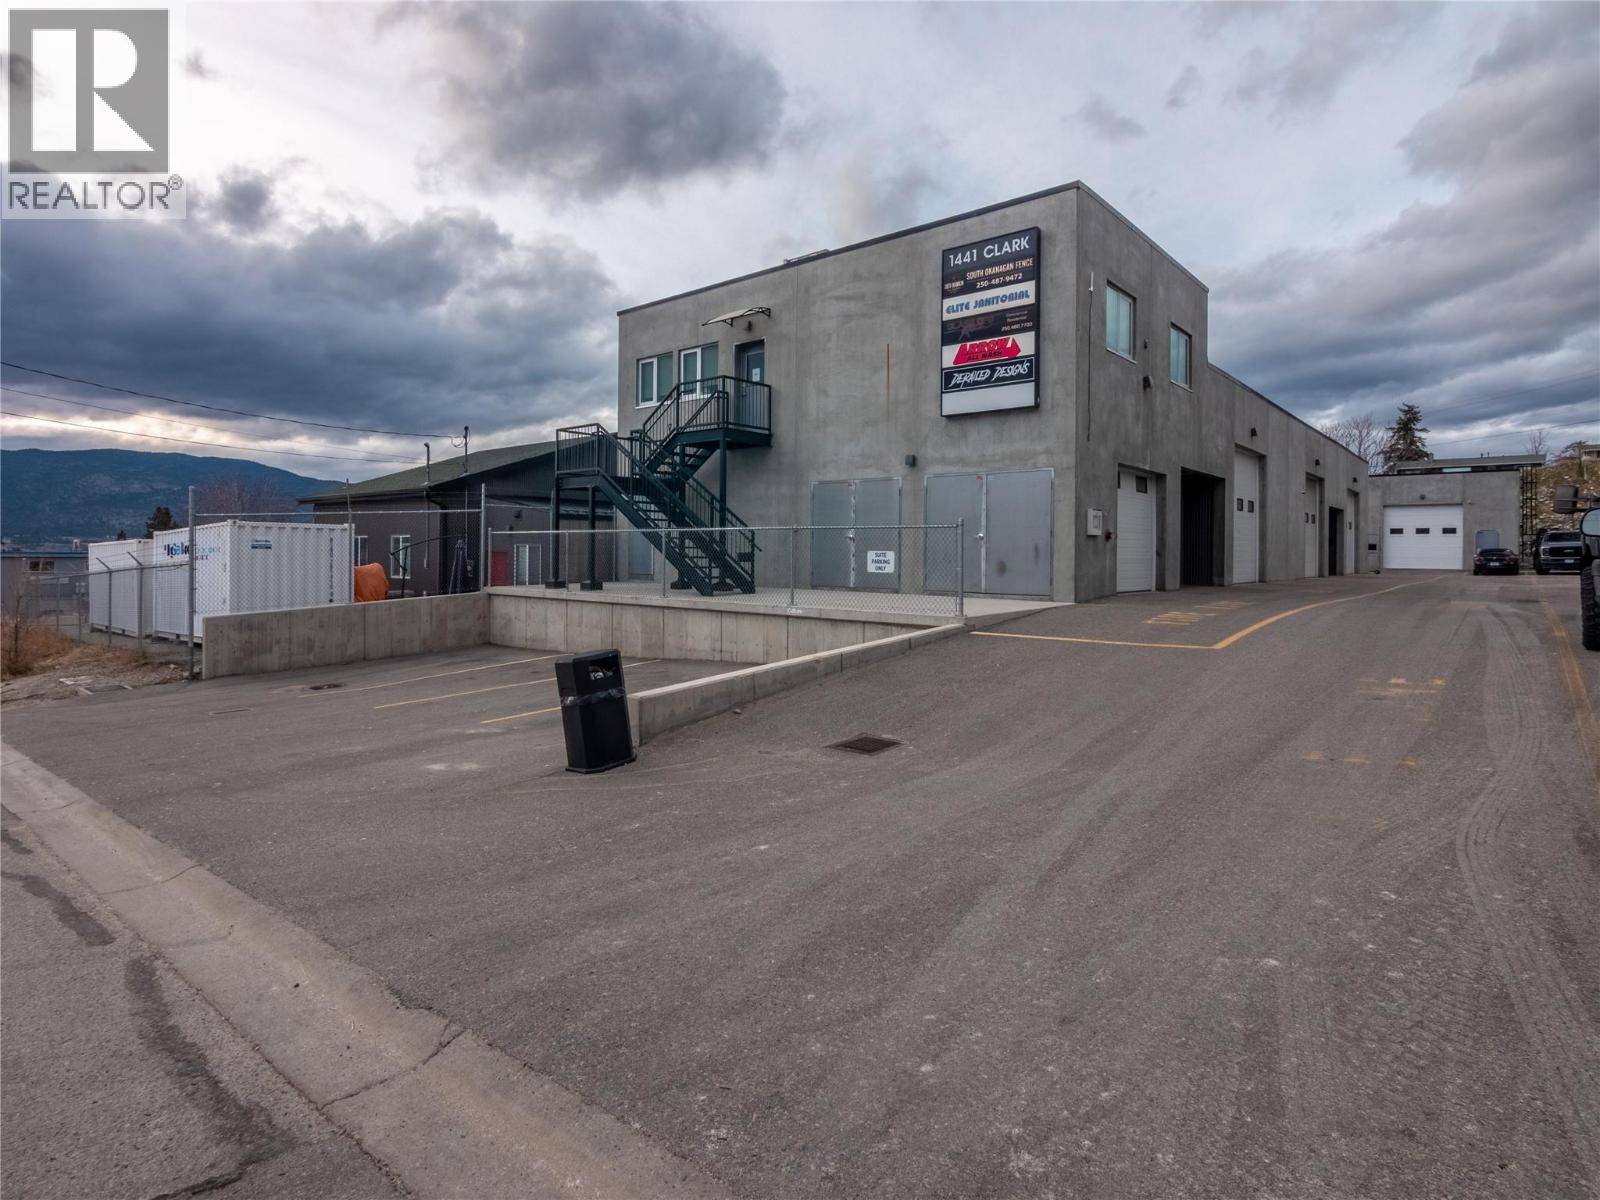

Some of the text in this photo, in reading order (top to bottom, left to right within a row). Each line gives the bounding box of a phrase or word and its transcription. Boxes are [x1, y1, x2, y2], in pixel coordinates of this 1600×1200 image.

[949, 235, 1030, 267] 1441 CLARK
[966, 257, 1034, 281] SOUTH OKANAGAN FENCE
[945, 289, 1030, 314] ELITE JANITORIAL
[948, 359, 1030, 390] DERAILED DESIGNS
